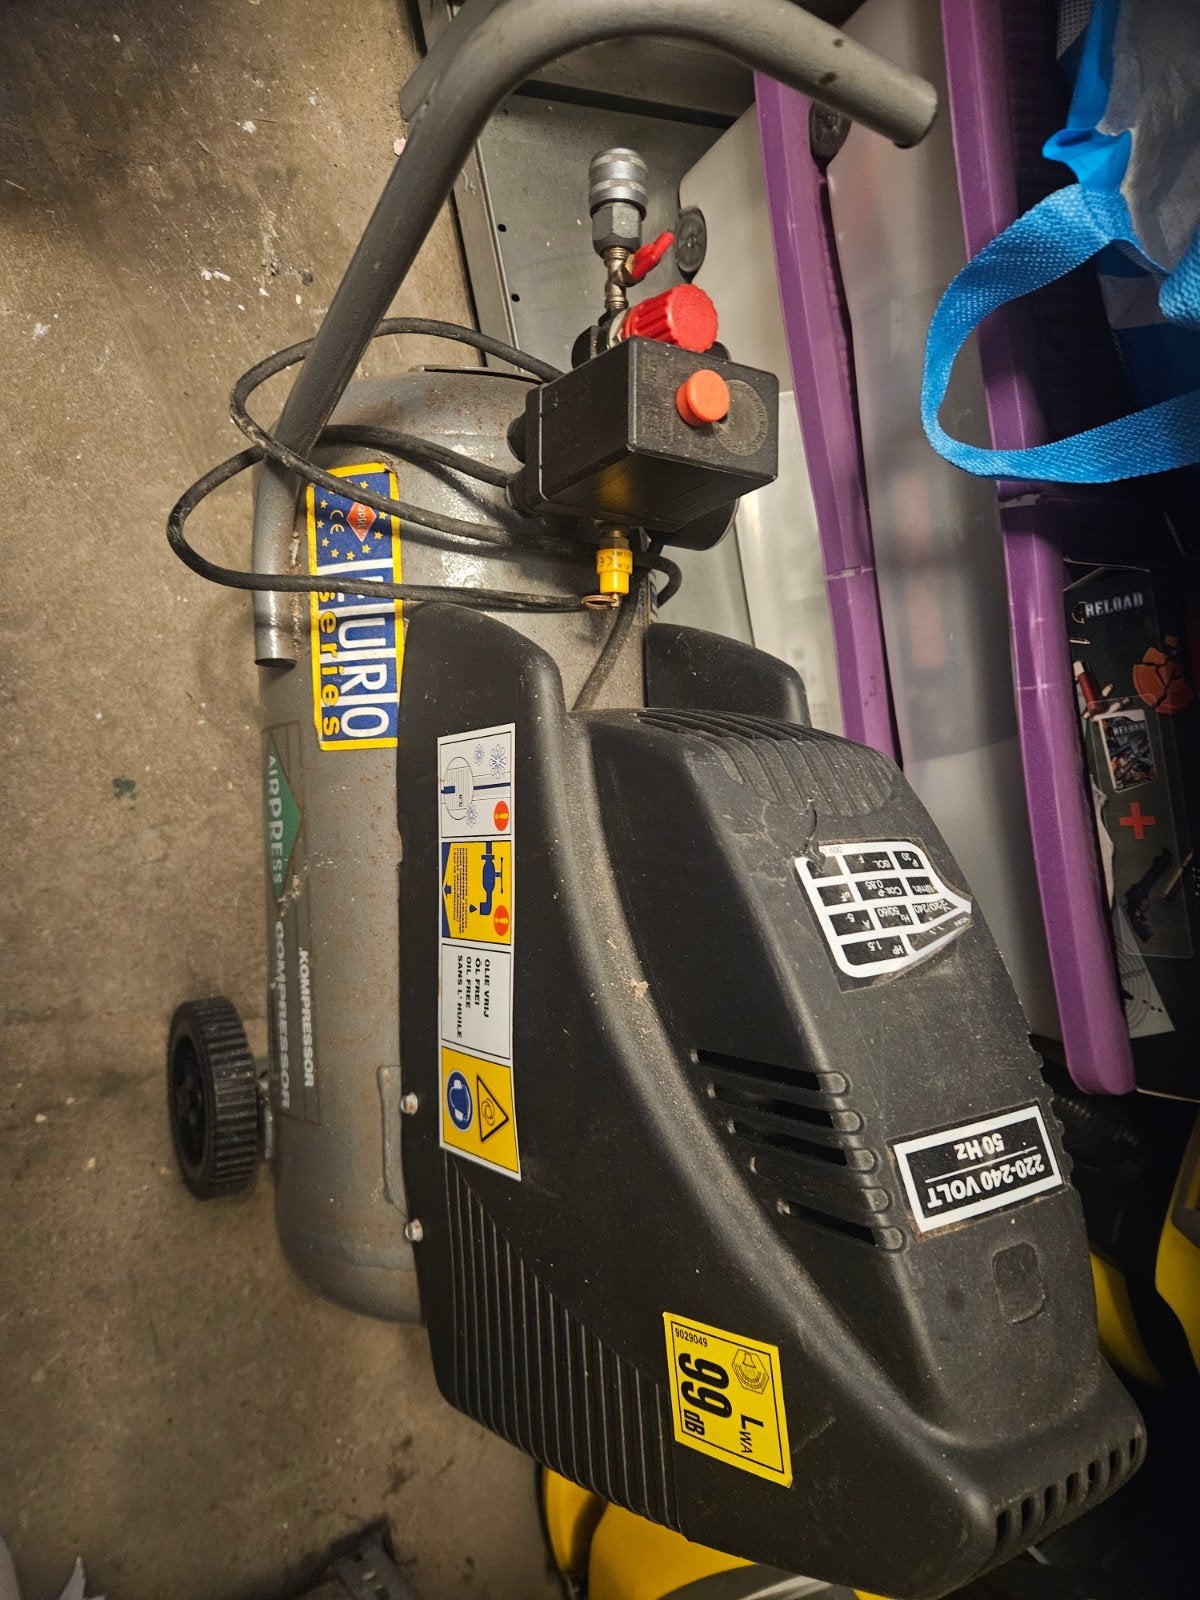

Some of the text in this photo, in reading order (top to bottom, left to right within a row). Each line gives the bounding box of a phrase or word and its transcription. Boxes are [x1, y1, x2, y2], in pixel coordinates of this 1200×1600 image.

[1085, 592, 1144, 618] RELOAD
[319, 591, 344, 736] series
[267, 755, 283, 884] AIRPRESS
[858, 855, 864, 864] F
[902, 853, 911, 861] 20
[865, 880, 883, 889] 0.85
[877, 907, 909, 922] Hz 50/60
[914, 899, 947, 913] 220/240
[862, 919, 869, 928] A
[868, 940, 904, 954] HP 1.5
[475, 958, 482, 974] ÖL
[275, 922, 291, 1108] COMPRESSOR
[298, 950, 314, 1087] KOMPRESSOR
[953, 1133, 1004, 1161] 50 Hz
[927, 1153, 1045, 1208] 220-240 VOLT
[675, 1328, 707, 1347] 9029049
[678, 1353, 732, 1436] 99 dB
